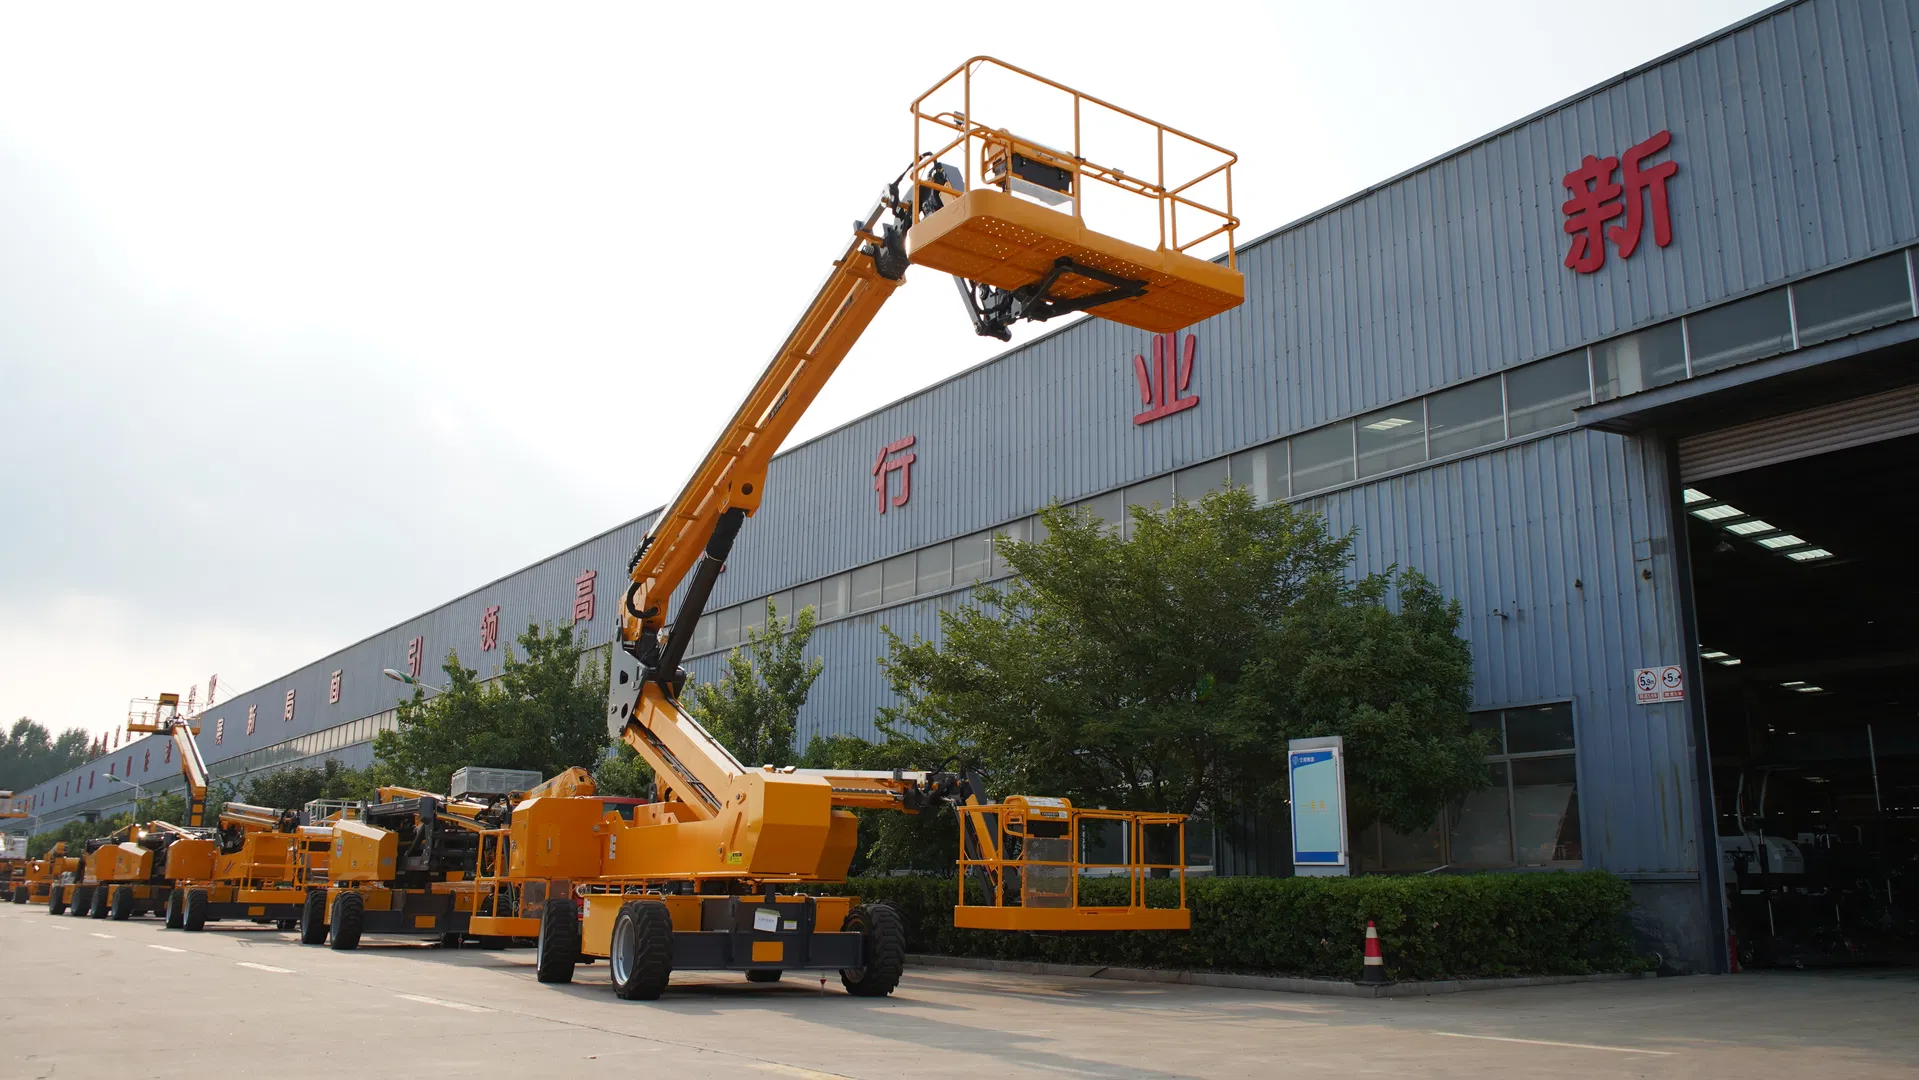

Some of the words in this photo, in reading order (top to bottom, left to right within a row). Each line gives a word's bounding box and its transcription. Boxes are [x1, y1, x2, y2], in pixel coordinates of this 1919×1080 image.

[329, 669, 343, 705] 面
[407, 635, 424, 677] 引
[480, 605, 500, 652] 领
[573, 569, 598, 625] 高
[872, 435, 916, 514] 行
[1133, 332, 1200, 425] 业
[1562, 129, 1679, 274] 新
